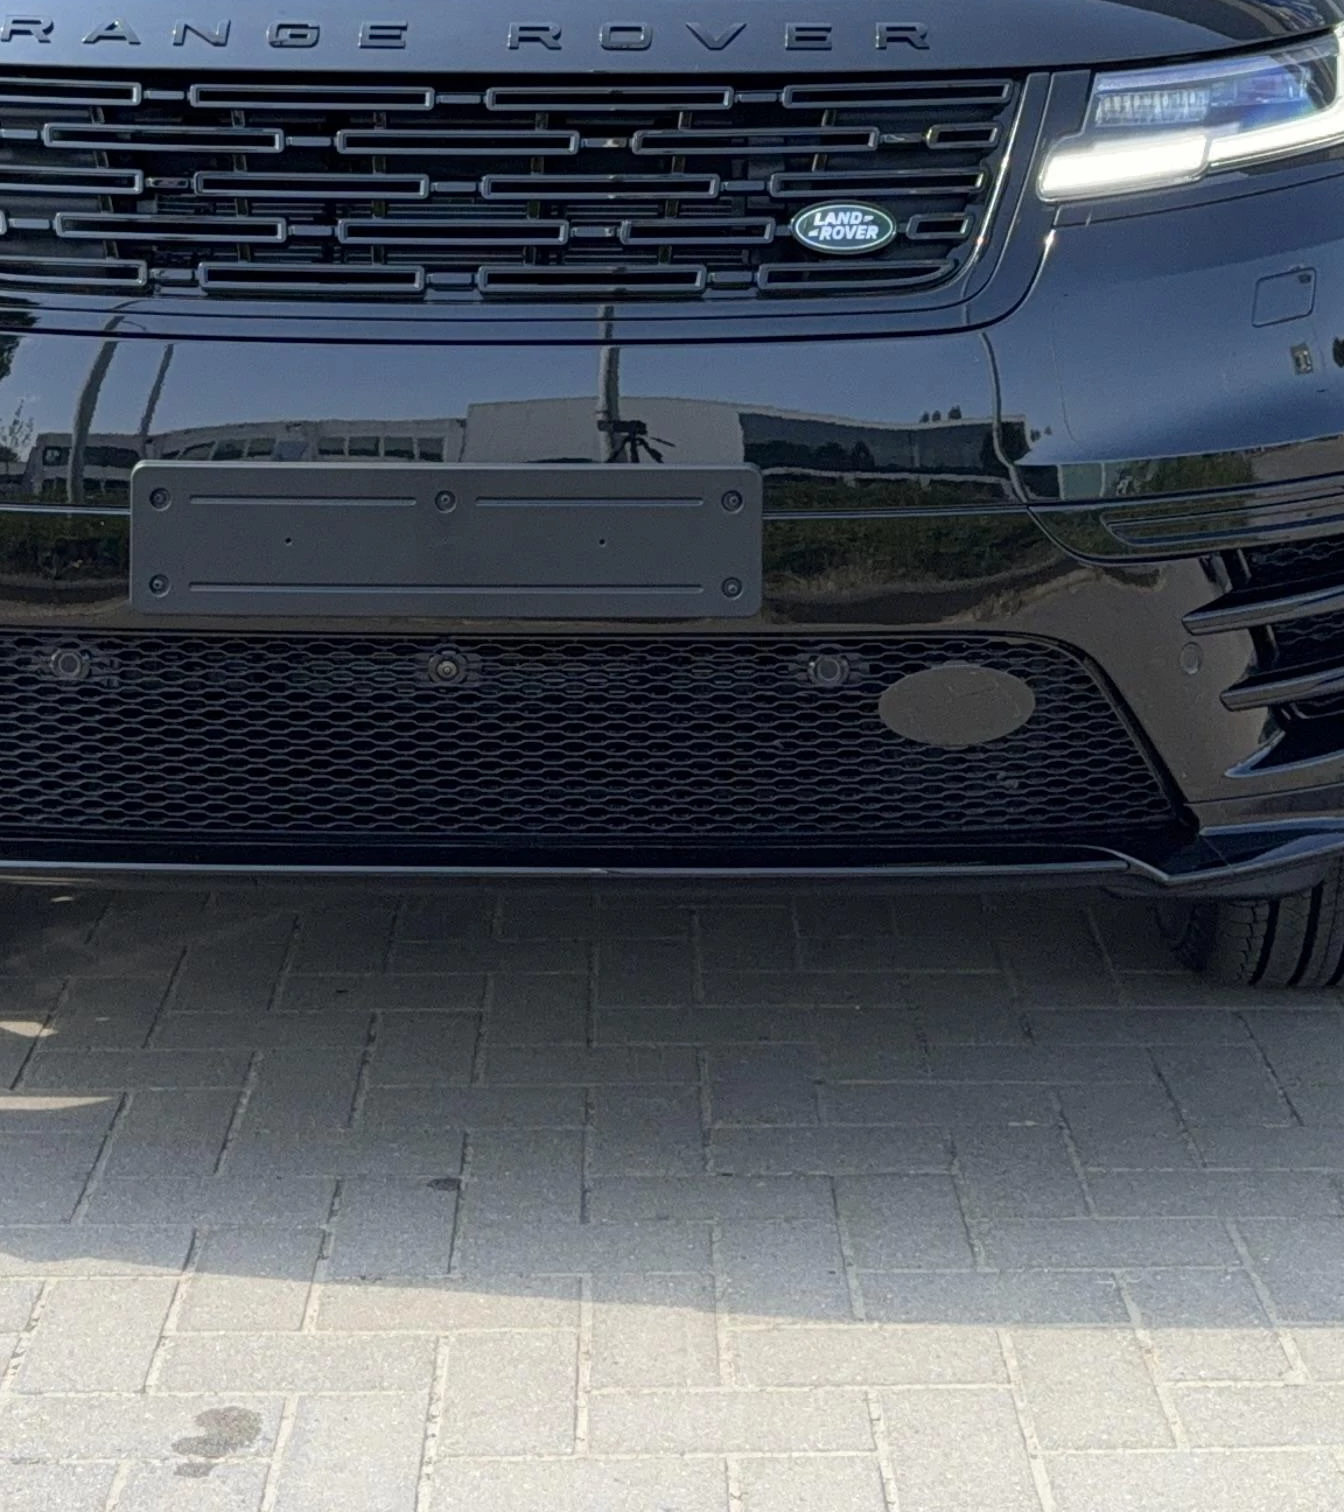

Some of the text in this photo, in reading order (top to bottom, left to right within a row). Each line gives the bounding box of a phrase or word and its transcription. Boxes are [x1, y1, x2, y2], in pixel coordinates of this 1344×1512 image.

[506, 19, 932, 52] ROVER
[813, 211, 863, 226] LAND
[819, 225, 879, 241] ROVER
